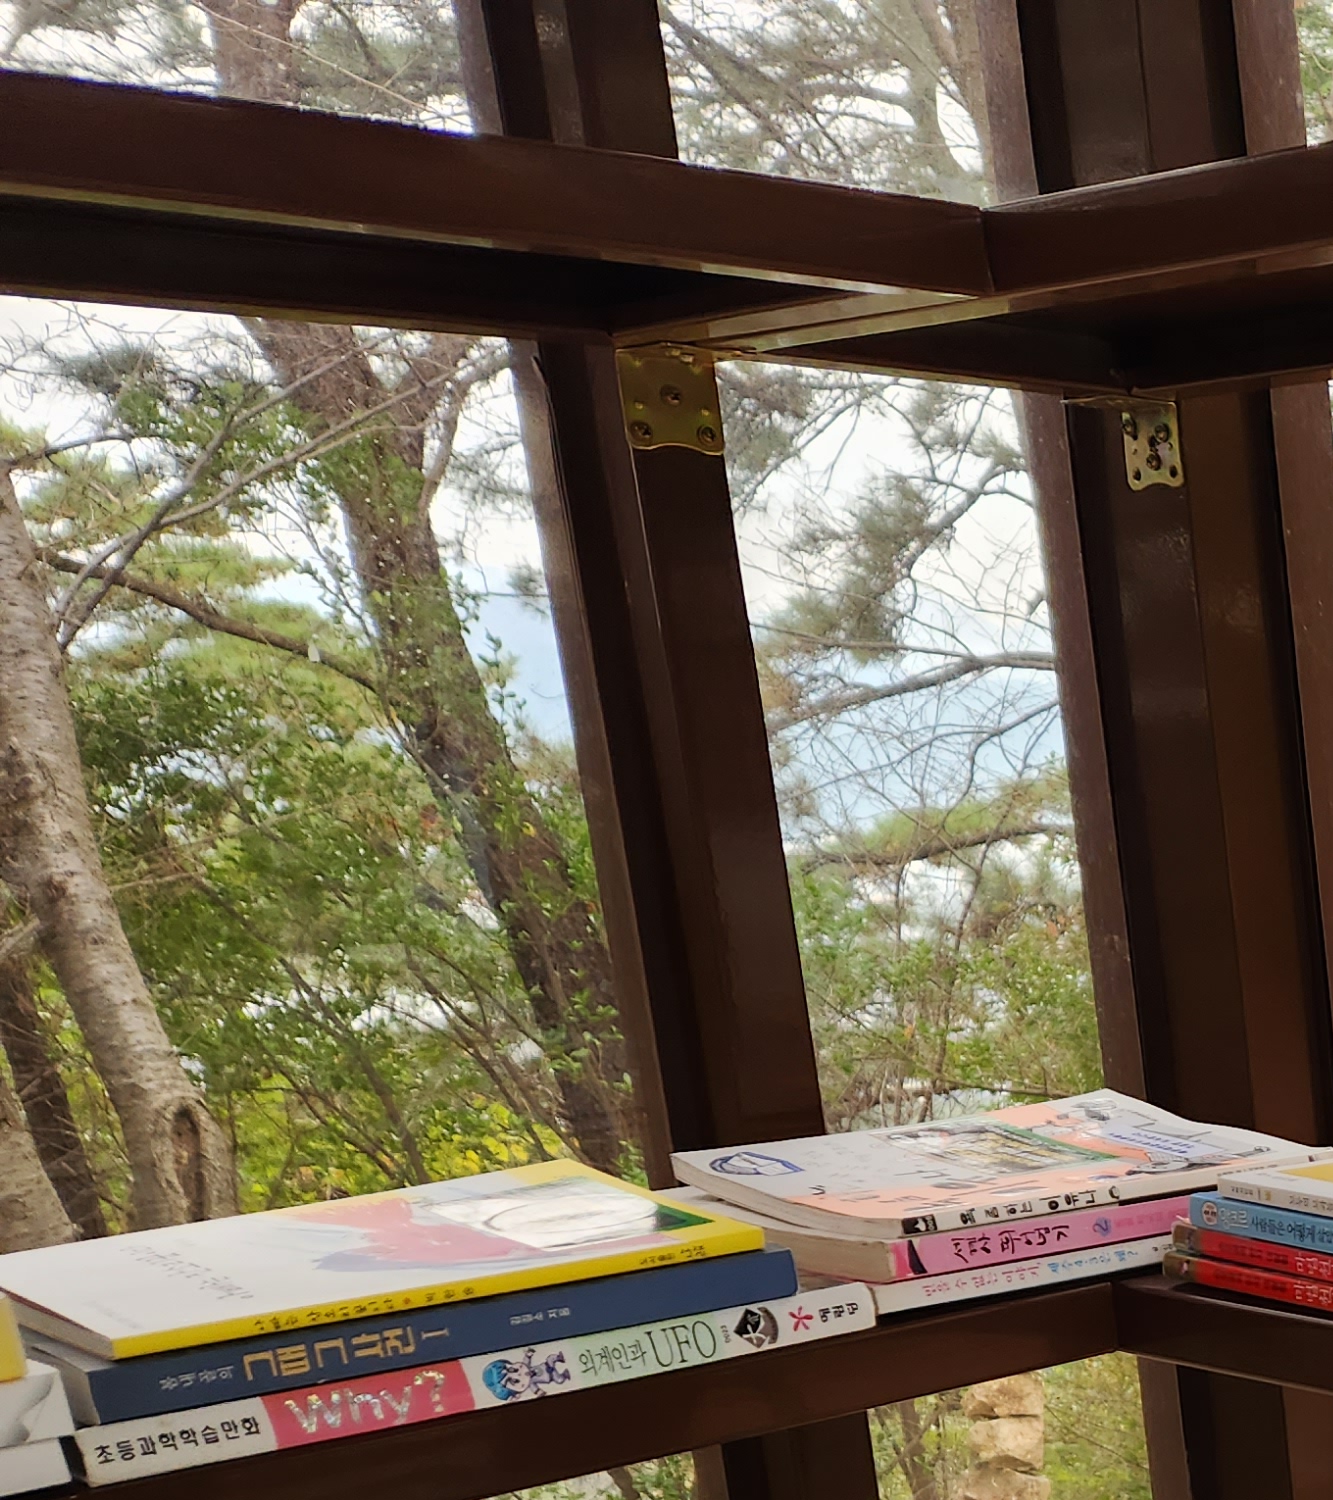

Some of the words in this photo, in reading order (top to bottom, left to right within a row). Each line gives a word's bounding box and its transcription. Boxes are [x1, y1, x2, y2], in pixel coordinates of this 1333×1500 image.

[1039, 1189, 1097, 1211] 이유나
[993, 1223, 1069, 1255] 뛰어넘기
[1251, 1216, 1285, 1236] 사람들은
[817, 1301, 859, 1324] 예림당
[243, 1343, 310, 1381] 그때
[313, 1337, 349, 1368] 그
[350, 1325, 417, 1359] 사건
[95, 1415, 261, 1465] 초등과학학습만화
[283, 1369, 444, 1433] Why?
[577, 1338, 648, 1377] 외계인과
[647, 1321, 717, 1368] UFO
